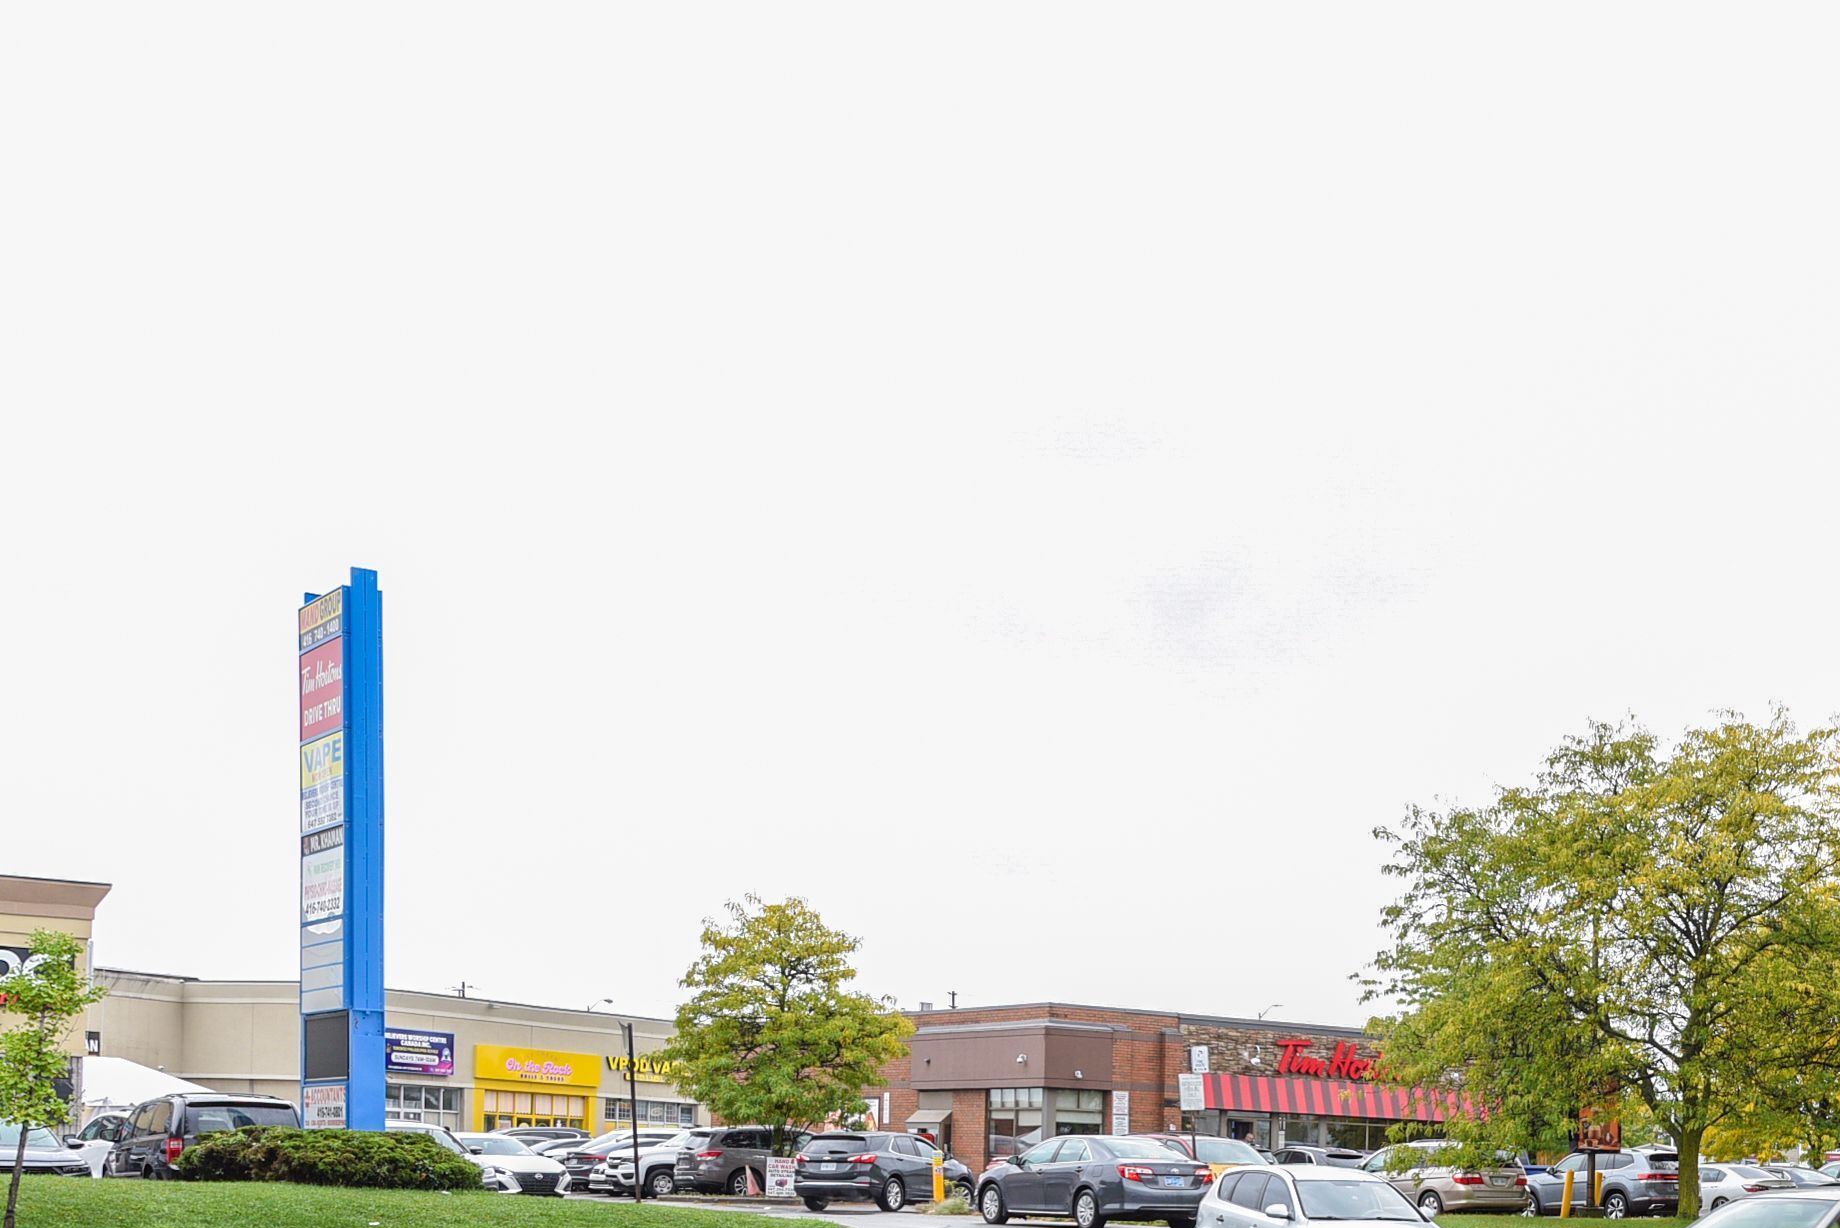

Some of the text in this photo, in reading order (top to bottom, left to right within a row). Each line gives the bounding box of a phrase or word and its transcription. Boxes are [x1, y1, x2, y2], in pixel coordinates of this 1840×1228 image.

[319, 591, 341, 621] GROUP
[302, 659, 342, 696] Tim Hortons
[304, 696, 341, 727] DRIVE THRU
[303, 738, 342, 774] VAPE
[506, 1058, 522, 1072] On
[525, 1059, 541, 1073] the
[1276, 1040, 1326, 1078] Tim
